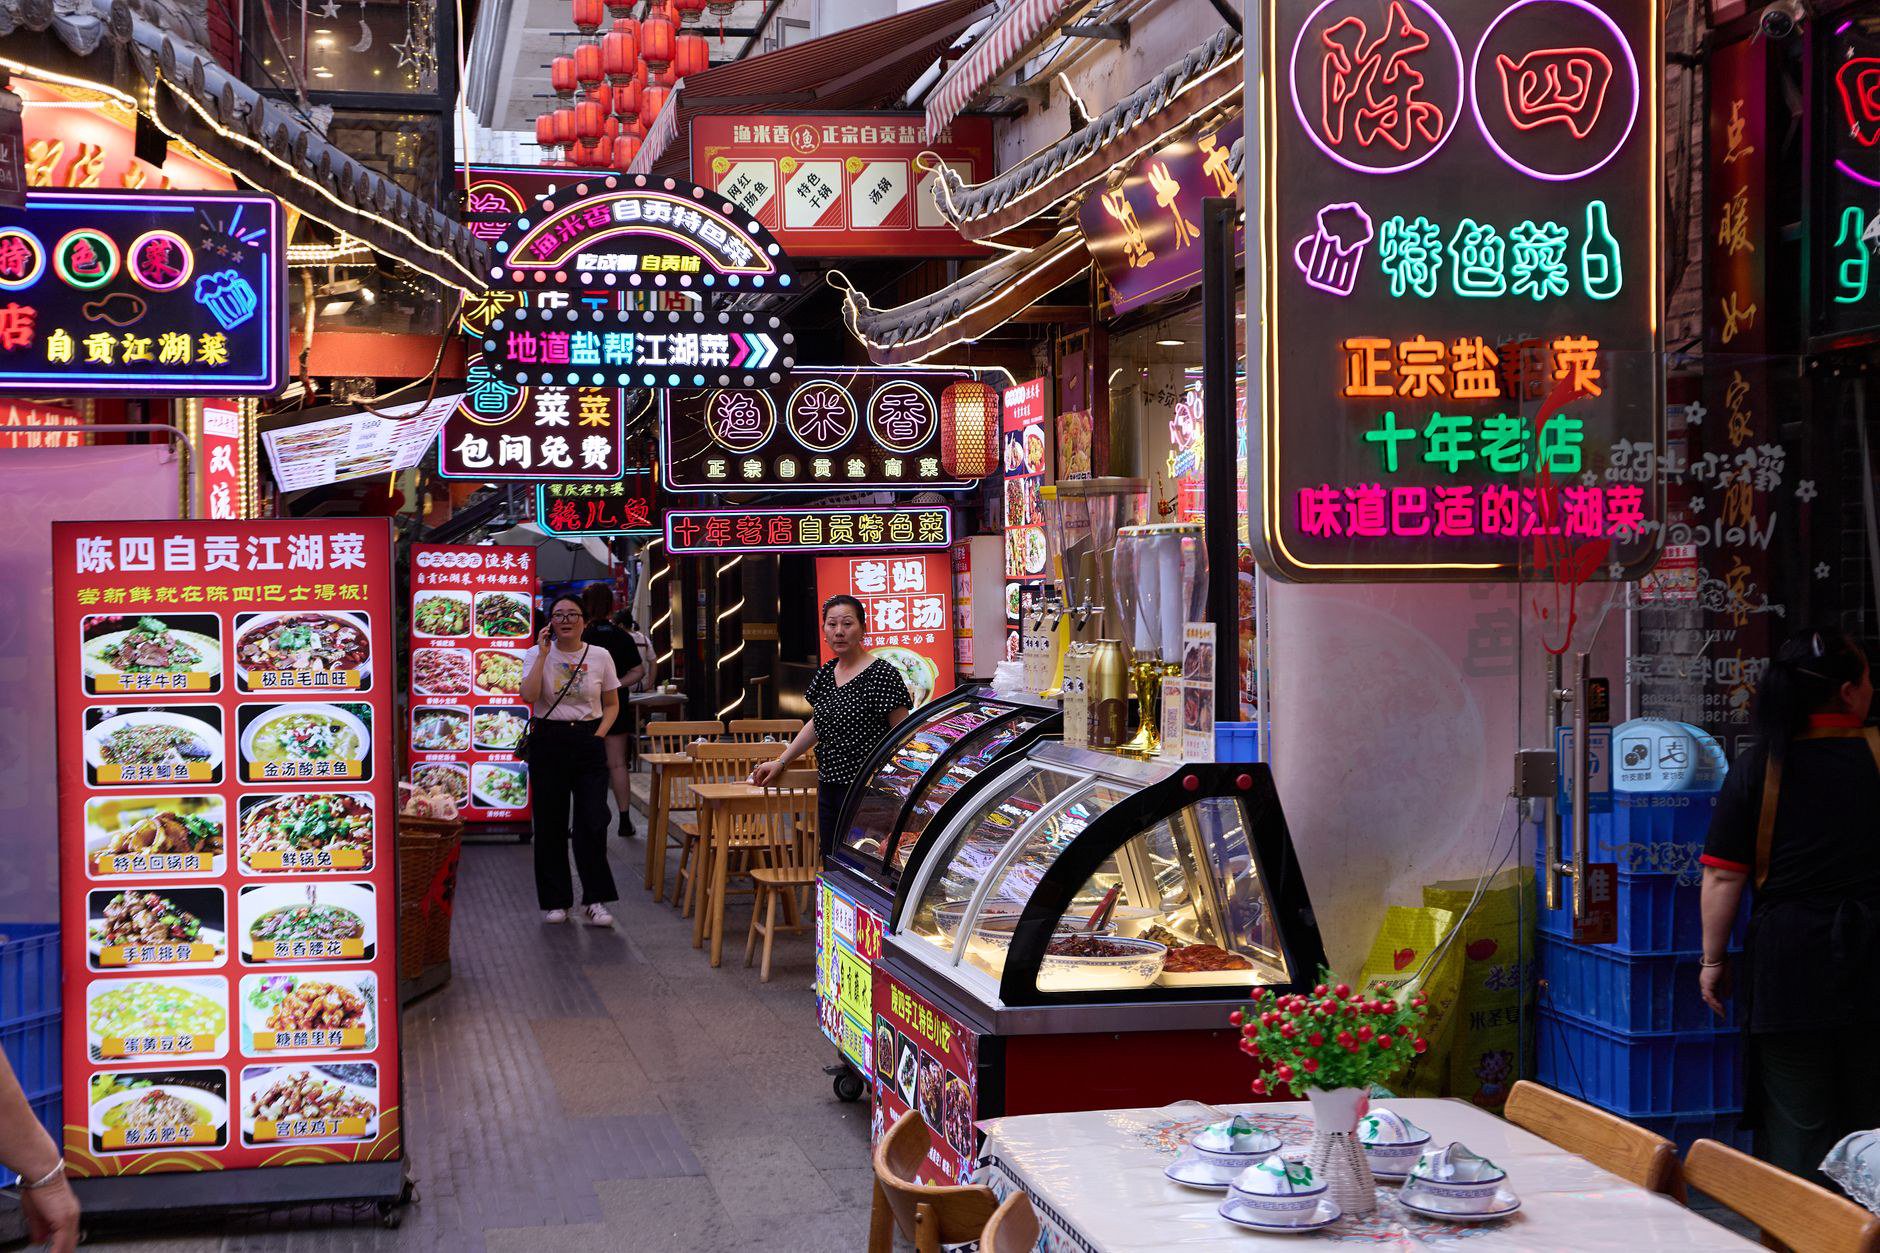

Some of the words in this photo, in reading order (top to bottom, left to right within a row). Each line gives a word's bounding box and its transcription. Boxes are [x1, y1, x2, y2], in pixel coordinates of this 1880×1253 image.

[733, 124, 790, 145] 渔米香
[727, 173, 752, 200] 网红
[797, 173, 821, 198] 特色
[808, 183, 833, 209] 干锅
[868, 177, 893, 205] 汤锅
[641, 254, 701, 272] 自贡味
[1379, 215, 1570, 301] 特色菜
[46, 327, 230, 366] 自贡江湖菜
[507, 330, 731, 368] 地道盐帮江湖菜
[717, 391, 927, 441] 渔米香
[1364, 411, 1585, 474] 十年老店
[706, 459, 940, 478] 正宗自贡盐商菜
[1299, 482, 1645, 537] 味道巴适的江湖菜
[673, 512, 944, 547] 十年老店自贡特色菜
[76, 532, 367, 574] 陈四自贡江湖菜
[485, 552, 531, 571] 渔米香
[854, 560, 925, 592] 老妈
[862, 597, 943, 632] 花汤
[262, 671, 347, 688] 极品毛血旺
[264, 762, 348, 777] 金汤酸菜鱼
[113, 854, 200, 871] 特色回锅肉
[281, 851, 333, 867] 鲜锅兔
[123, 946, 192, 963] 手抓排骨
[274, 940, 343, 957] 葱香腰花
[124, 1034, 193, 1053] 蛋黄豆花
[275, 1030, 343, 1047] 糖醋里脊
[125, 1126, 193, 1144] 酸汤肥牛
[276, 1118, 342, 1136] 宫保鸡丁
